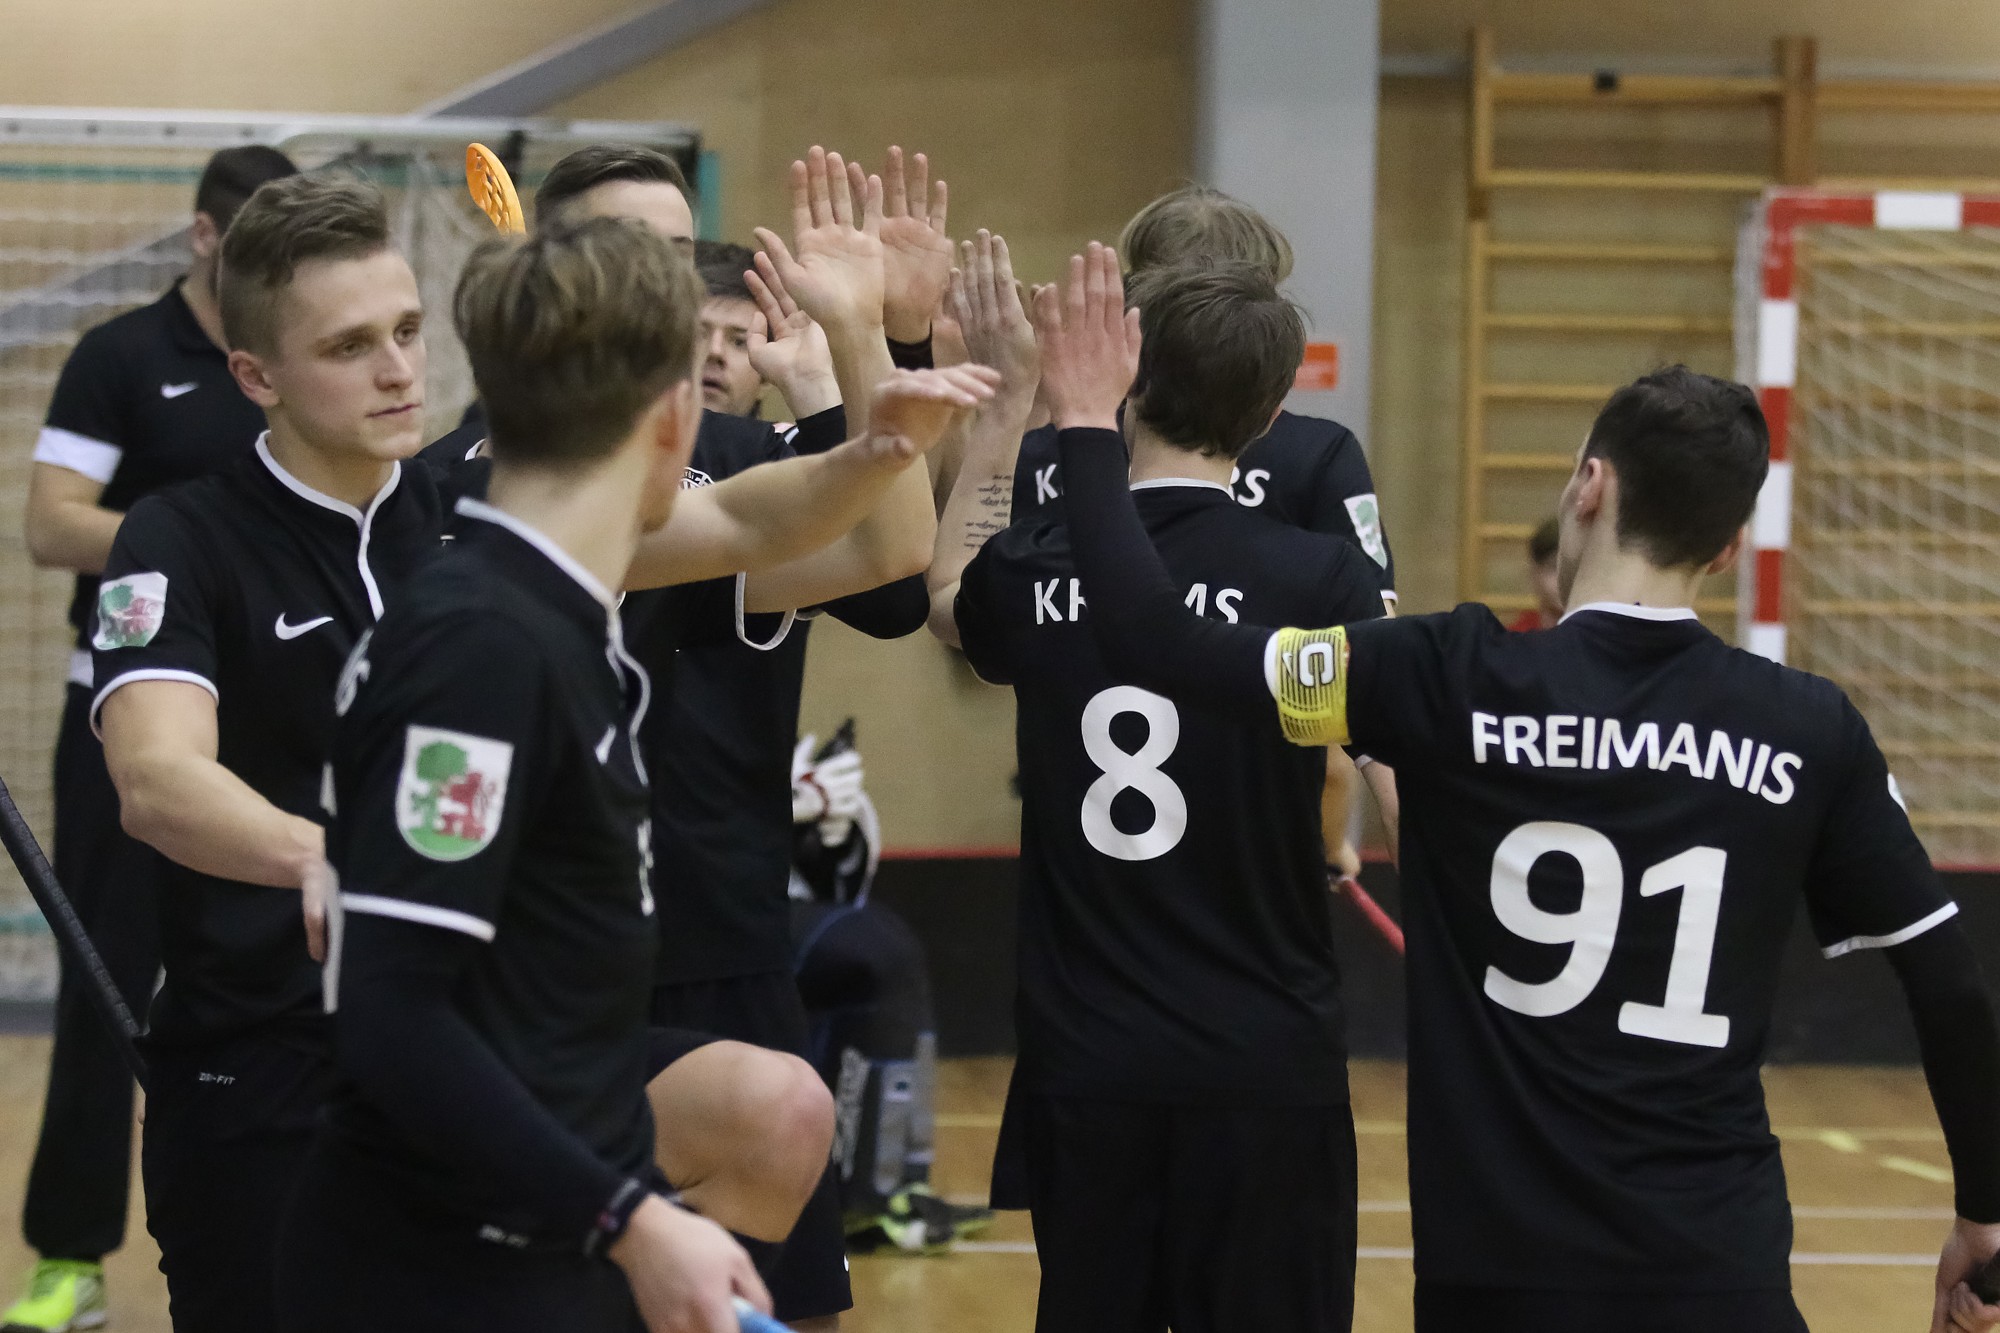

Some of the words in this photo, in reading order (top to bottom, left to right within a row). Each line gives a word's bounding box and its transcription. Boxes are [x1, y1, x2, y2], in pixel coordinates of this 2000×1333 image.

[1081, 685, 1188, 861] 8
[1471, 711, 1803, 805] FREIMANIS
[1483, 820, 1731, 1049] 91
